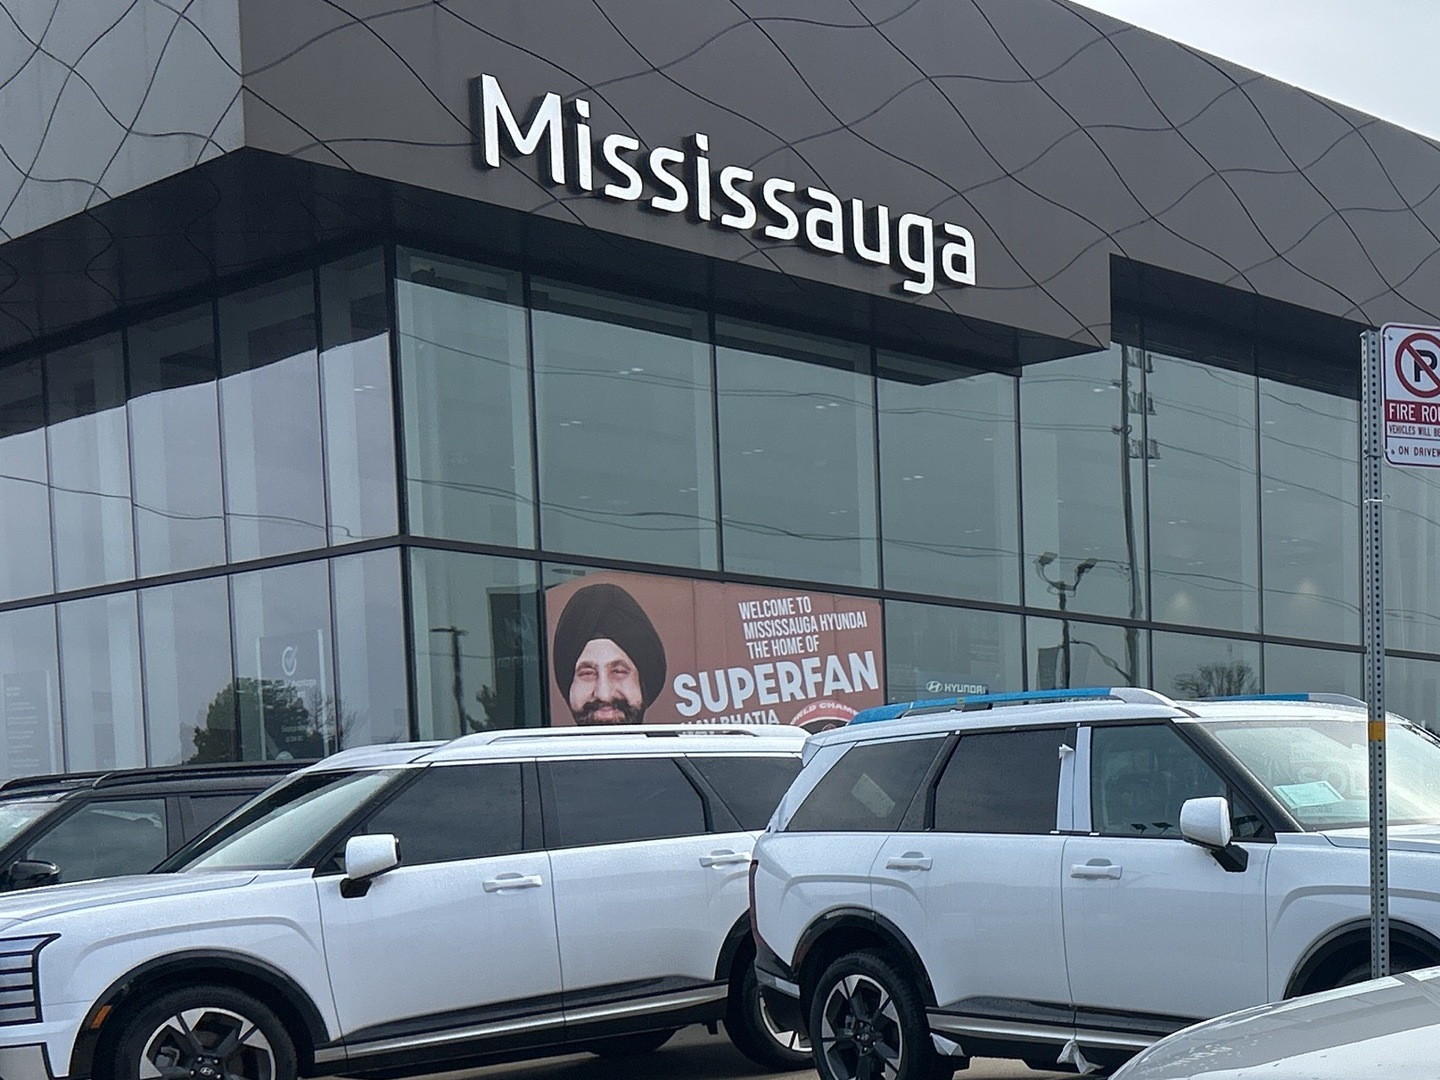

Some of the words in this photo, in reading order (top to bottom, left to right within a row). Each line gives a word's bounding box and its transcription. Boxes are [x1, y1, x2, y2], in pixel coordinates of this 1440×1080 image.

[480, 73, 976, 295] Mississauga
[1388, 402, 1417, 421] FIRE
[1388, 424, 1416, 436] VEHICLES
[1418, 426, 1432, 437] WILL
[1398, 446, 1410, 456] ON
[738, 597, 796, 620] WELCOME
[796, 595, 812, 614] TO
[743, 615, 819, 640] MISSISSAUGA
[819, 610, 868, 632] HYUNDAI
[746, 640, 771, 660] THE
[771, 636, 805, 657] HOME
[805, 634, 820, 653] OF
[673, 650, 880, 718] SUPERFAN
[944, 683, 987, 694] HYUNDAI
